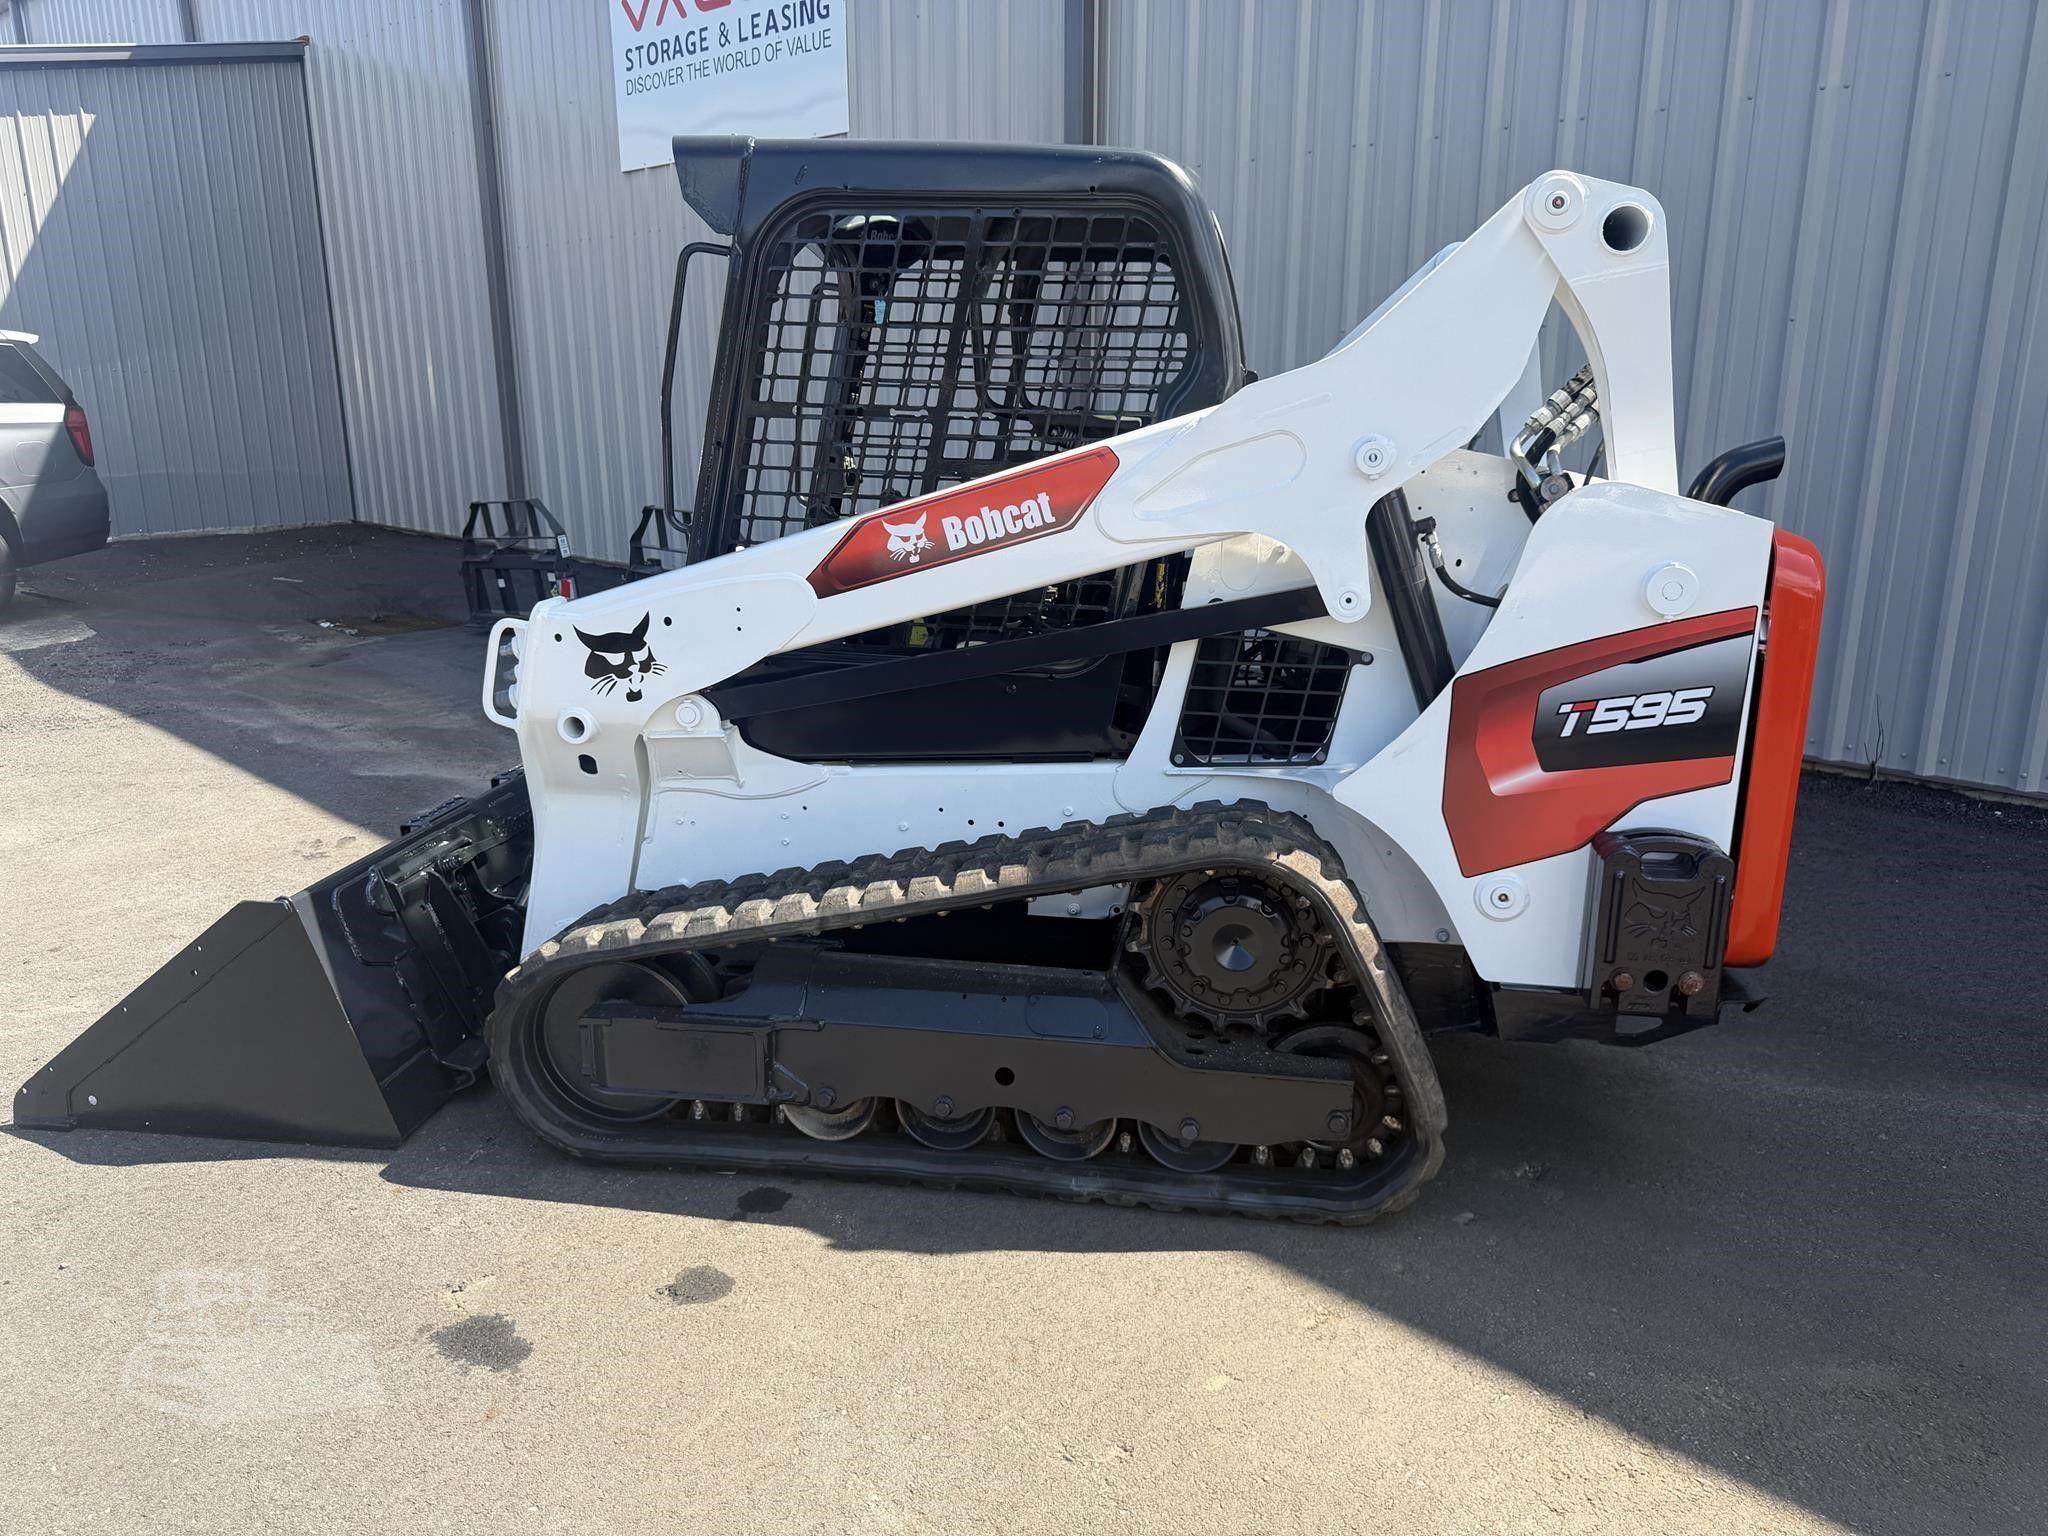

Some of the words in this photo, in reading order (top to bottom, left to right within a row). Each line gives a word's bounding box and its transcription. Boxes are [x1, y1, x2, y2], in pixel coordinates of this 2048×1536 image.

[625, 26, 709, 72] STORAGE
[718, 21, 731, 48] &
[738, 0, 830, 43] LEASING
[625, 66, 684, 96] DISCOVER
[686, 59, 710, 81] THE
[713, 46, 761, 75] WORLD
[764, 40, 783, 62] OF
[786, 28, 832, 56] VALUE
[941, 491, 1056, 552] Bobcat
[1556, 686, 1715, 738] T595
